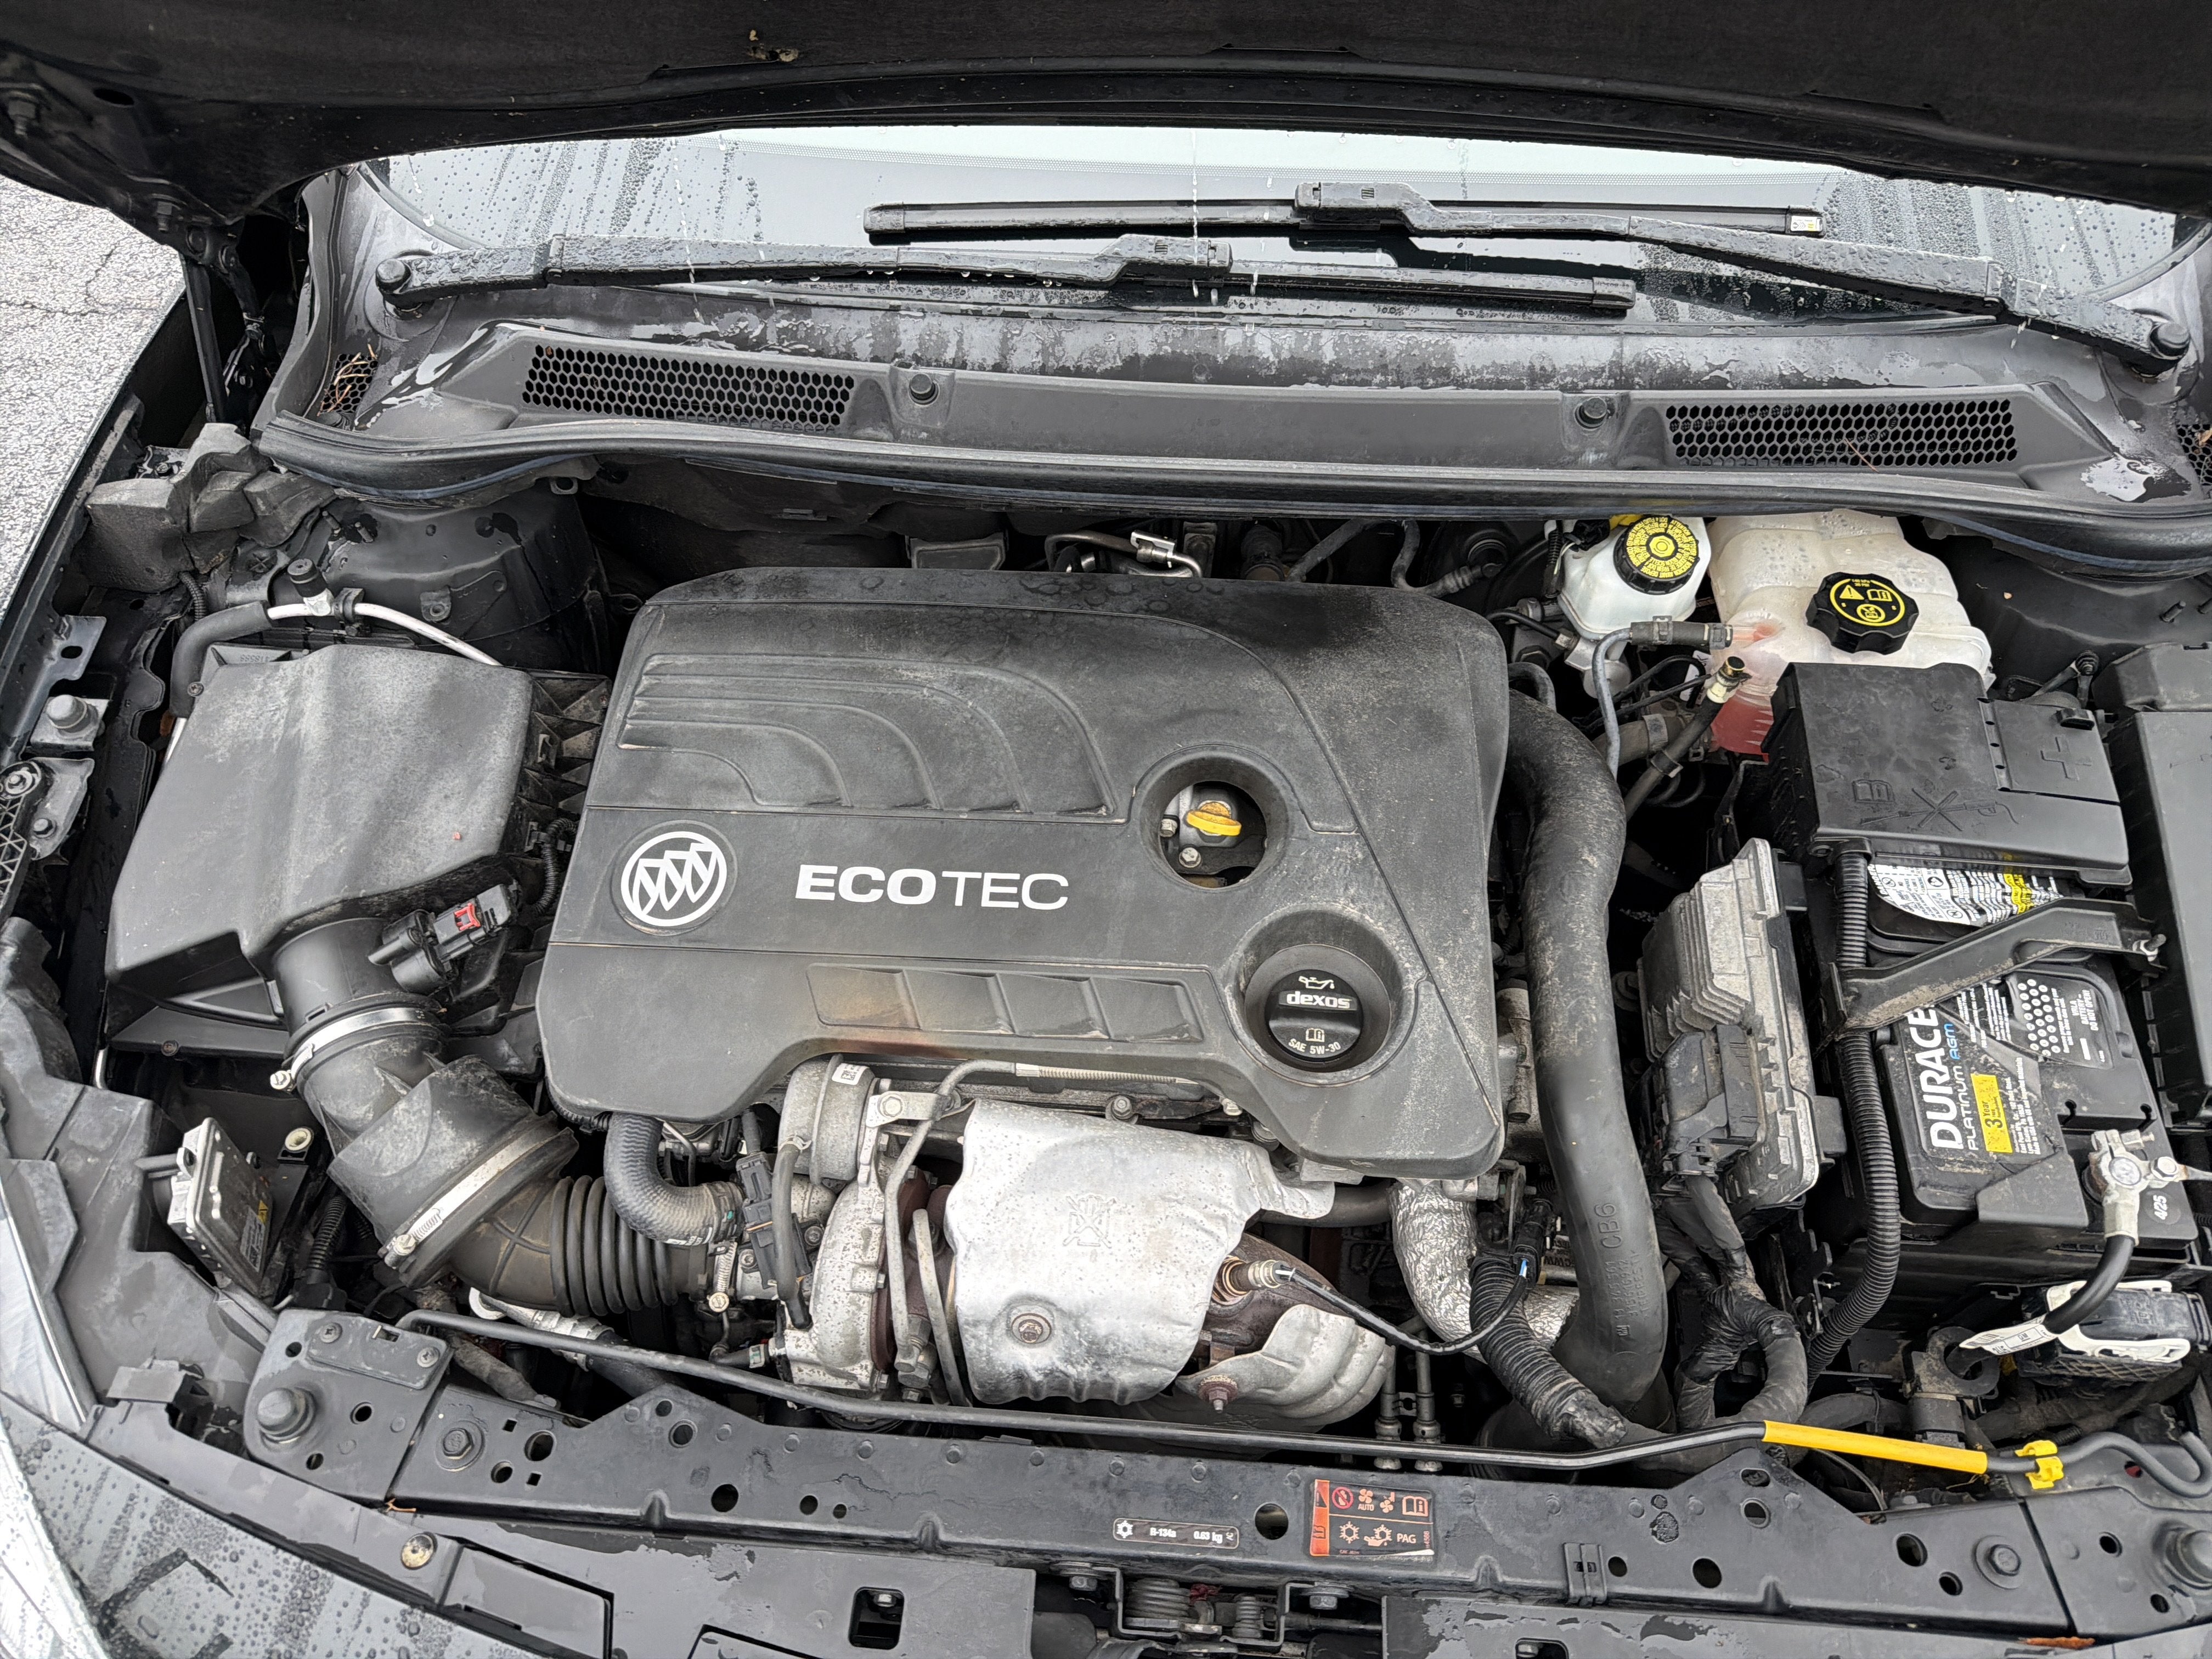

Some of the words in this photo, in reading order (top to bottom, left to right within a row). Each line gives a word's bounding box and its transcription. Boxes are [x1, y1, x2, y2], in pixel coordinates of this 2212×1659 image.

[795, 864, 1069, 910] ECOTEC
[1286, 991, 1350, 1008] dexos
[2070, 1000, 2080, 1016] VRLA
[2076, 998, 2089, 1024] BATTERY
[2086, 1008, 2096, 1021] NOT
[2089, 1022, 2099, 1031] DO
[1288, 1038, 1307, 1052] SAE
[1310, 1041, 1341, 1055] 5W-30
[1905, 1004, 1964, 1150] DURACE
[1954, 1065, 1978, 1151] PLATINUM
[1982, 1101, 1990, 1116] Year
[1985, 1118, 2003, 1128] 3
[2153, 1194, 2168, 1220] 4/25
[1594, 1203, 1623, 1248] CB6
[1358, 1503, 1375, 1511] AUTO
[1150, 1527, 1177, 1538] R-134a
[1193, 1531, 1210, 1540] 0.63
[1212, 1532, 1223, 1544] kg
[1397, 1533, 1417, 1544] PAG
